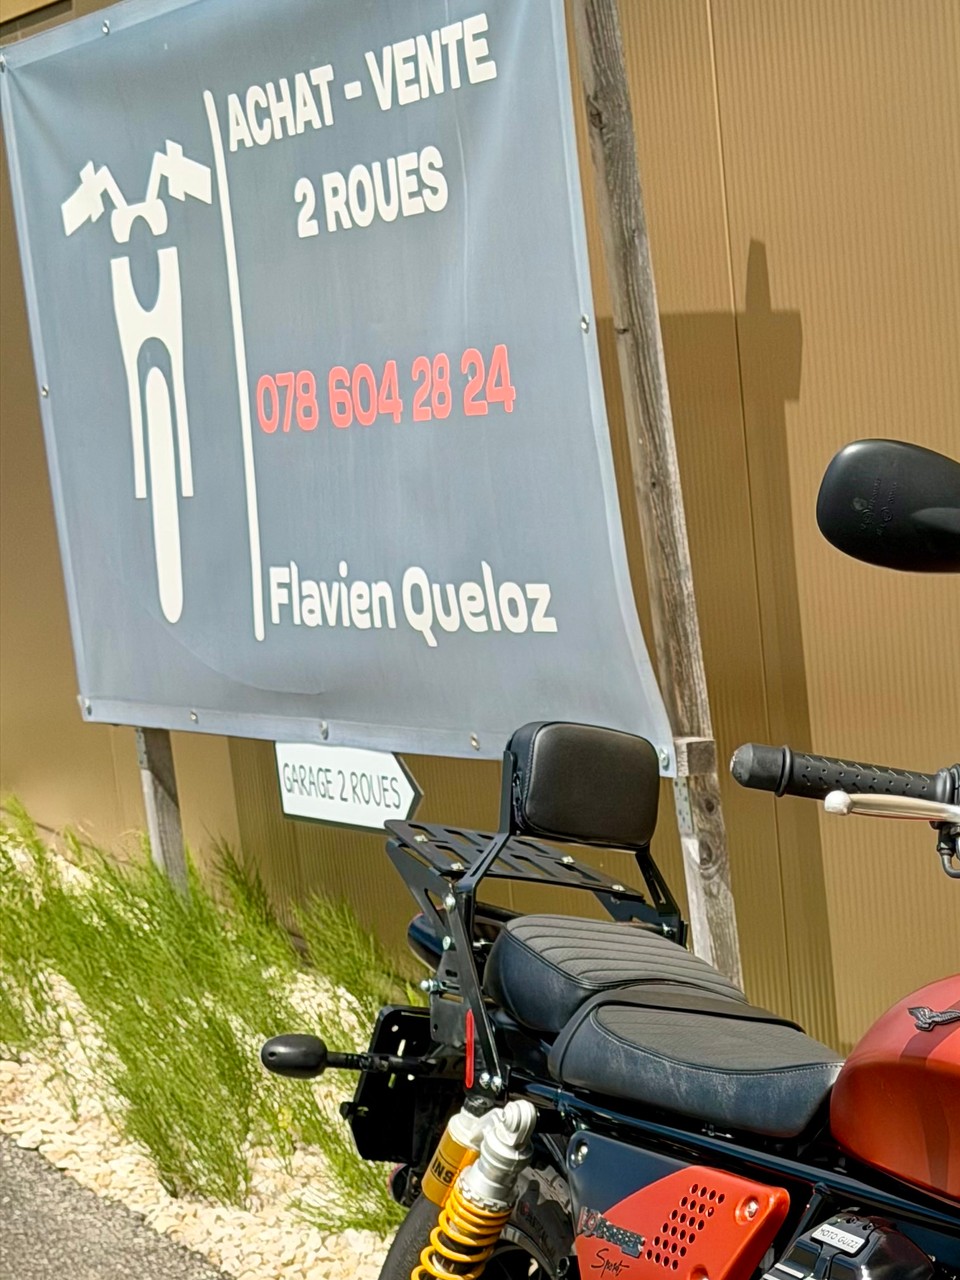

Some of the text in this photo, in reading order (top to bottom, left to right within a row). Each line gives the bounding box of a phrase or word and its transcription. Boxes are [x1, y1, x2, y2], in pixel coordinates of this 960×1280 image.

[227, 64, 335, 152] ACHAT
[365, 13, 498, 112] VENTE
[294, 145, 449, 238] 2 ROUES
[256, 343, 516, 434] 078 604 28 24
[269, 560, 558, 647] Flavien Queloz
[282, 762, 401, 809] GARAGE 2 ROUES
[819, 1227, 859, 1249] MOTO GUZZI
